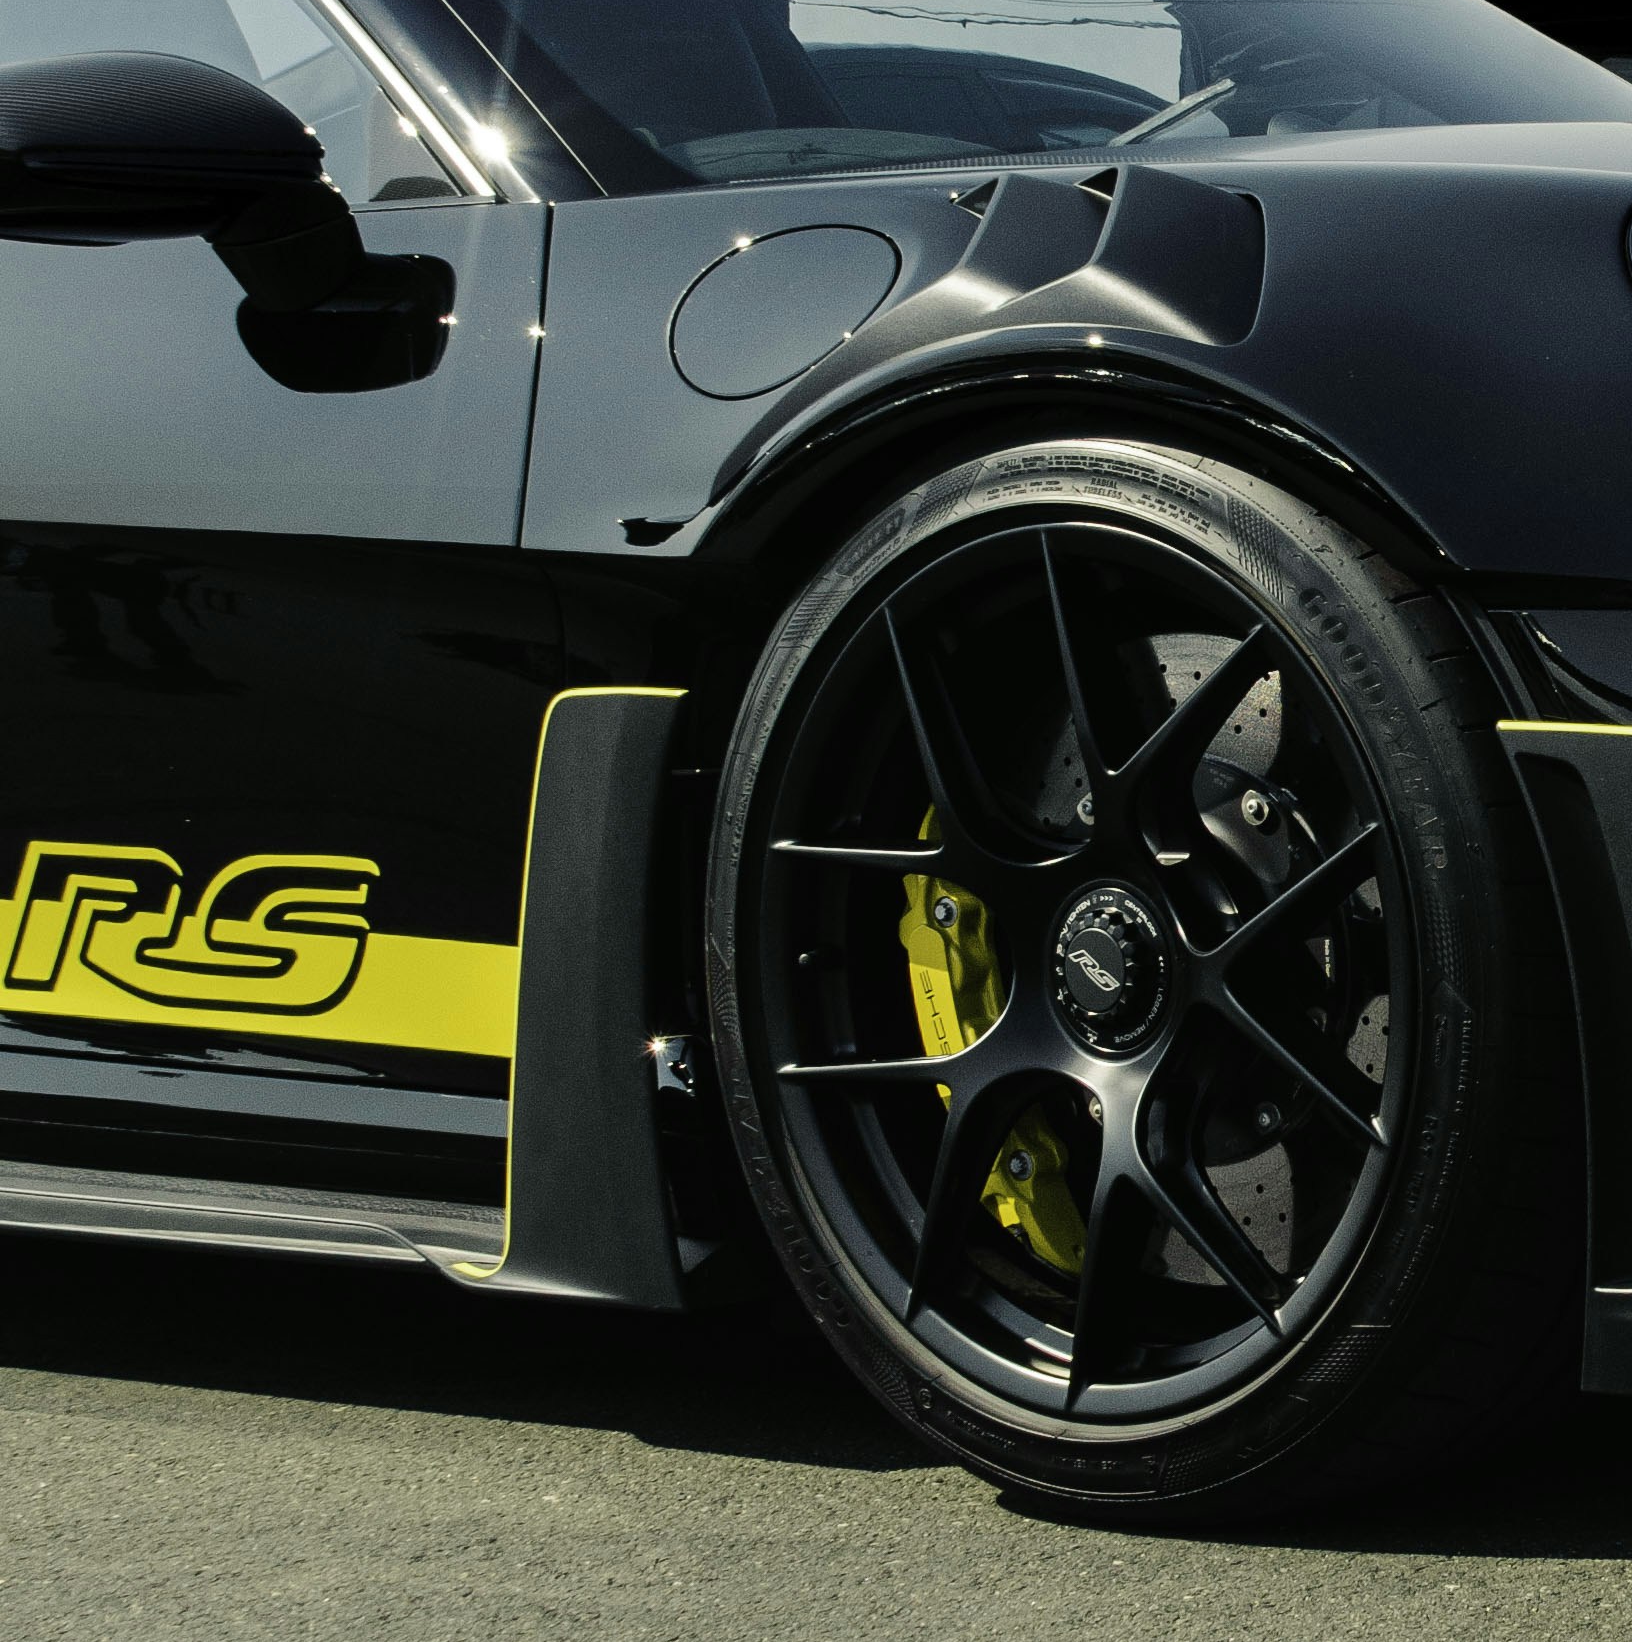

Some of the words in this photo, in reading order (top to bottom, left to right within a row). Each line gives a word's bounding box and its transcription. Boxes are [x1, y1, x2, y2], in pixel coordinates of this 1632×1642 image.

[4, 840, 381, 1017] RS
[1124, 899, 1158, 938] CENTERLOCK
[1067, 949, 1121, 993] RS
[919, 968, 953, 1056] SCHE
